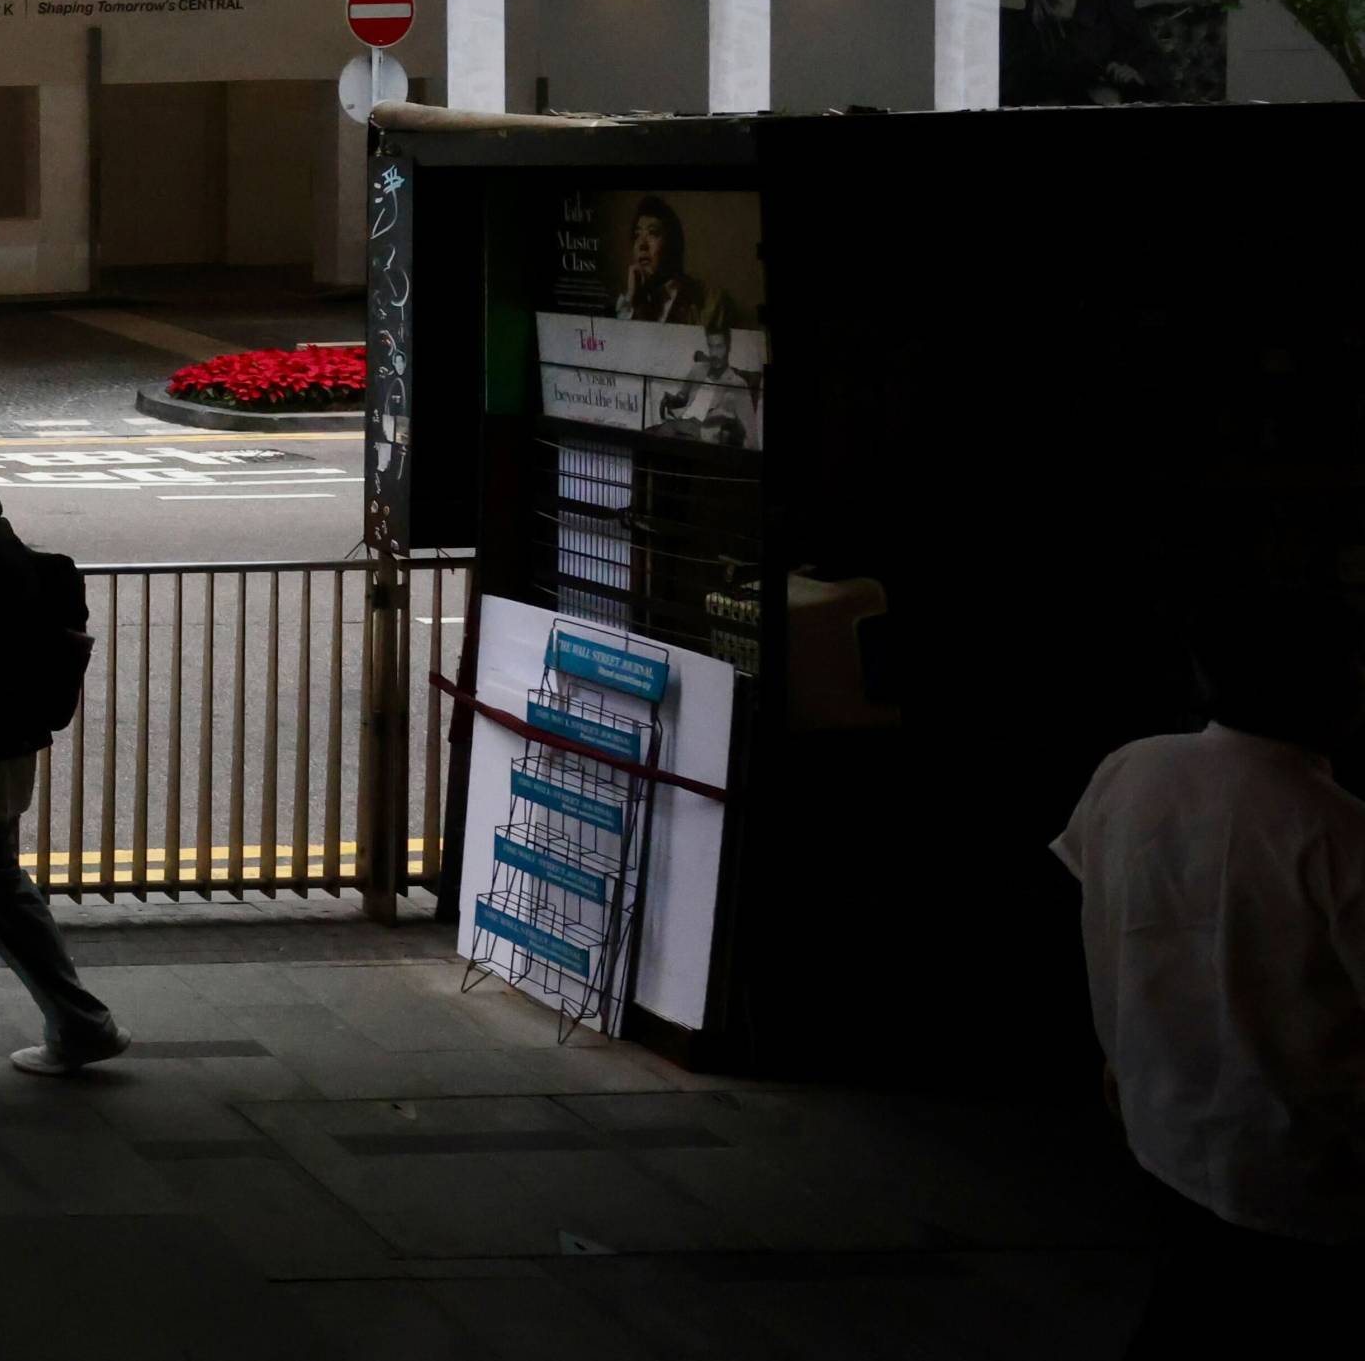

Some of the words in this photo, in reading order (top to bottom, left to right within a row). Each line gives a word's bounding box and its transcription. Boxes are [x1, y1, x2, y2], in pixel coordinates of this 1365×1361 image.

[37, 0, 94, 17] Shaping
[557, 230, 600, 252] Master
[561, 252, 597, 273] Class
[552, 383, 593, 409] beyond
[595, 387, 613, 409] the
[615, 392, 639, 415] field
